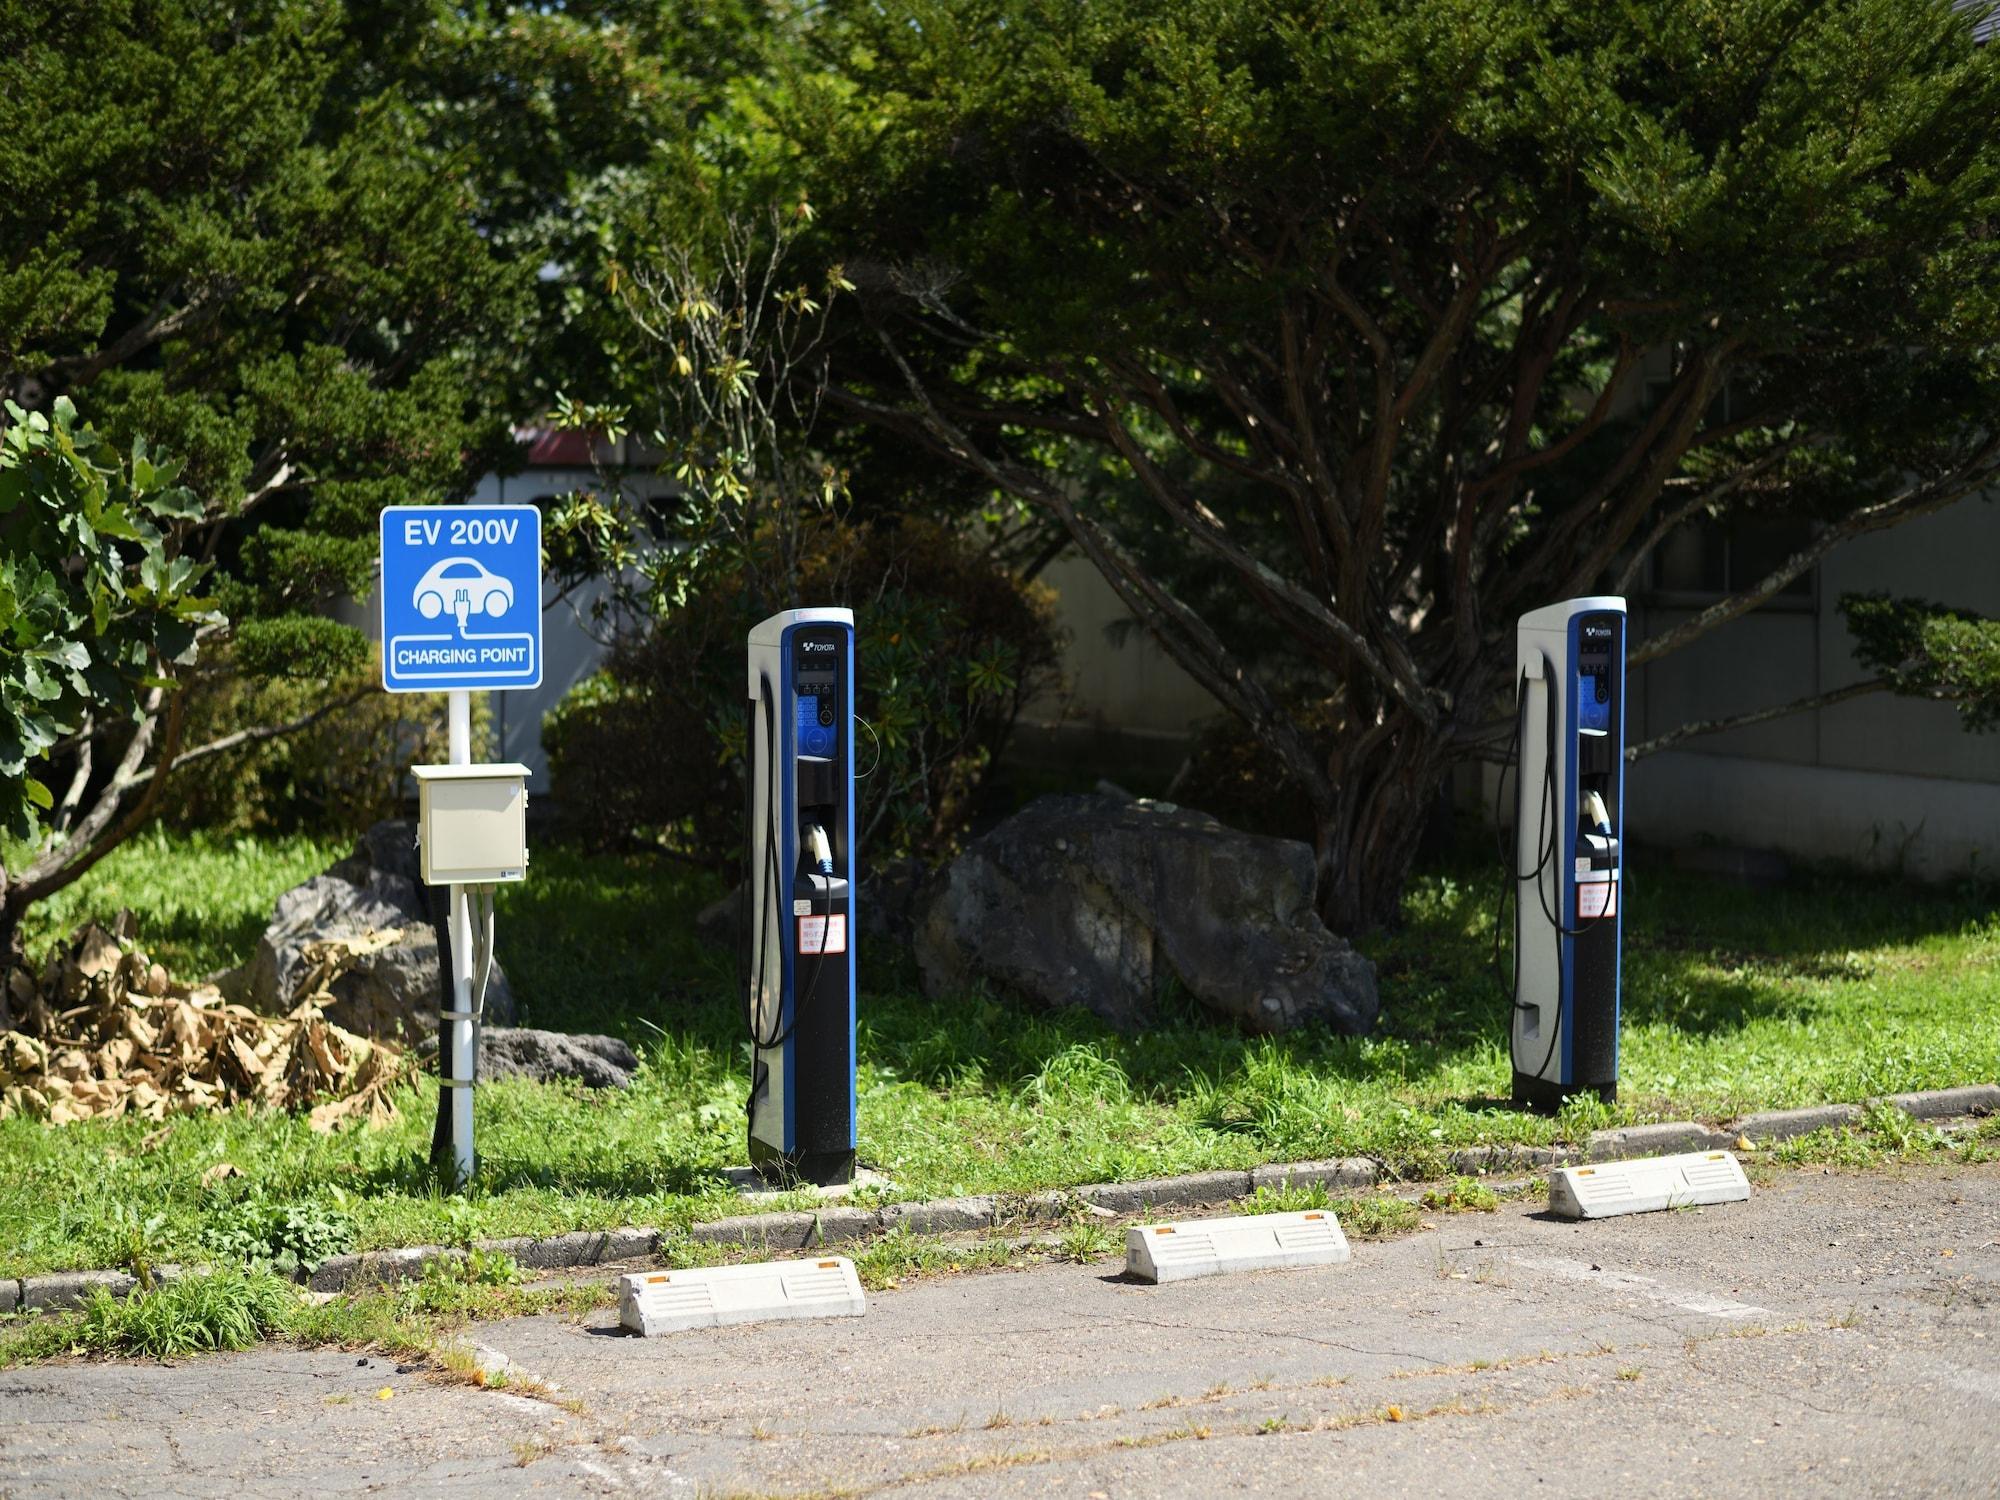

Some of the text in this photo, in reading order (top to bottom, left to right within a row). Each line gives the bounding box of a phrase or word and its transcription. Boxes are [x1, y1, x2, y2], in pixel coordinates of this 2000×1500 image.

[405, 518, 519, 545] EV 200V
[398, 647, 526, 665] CHARGING POINT
[813, 643, 835, 652] TOYOTA
